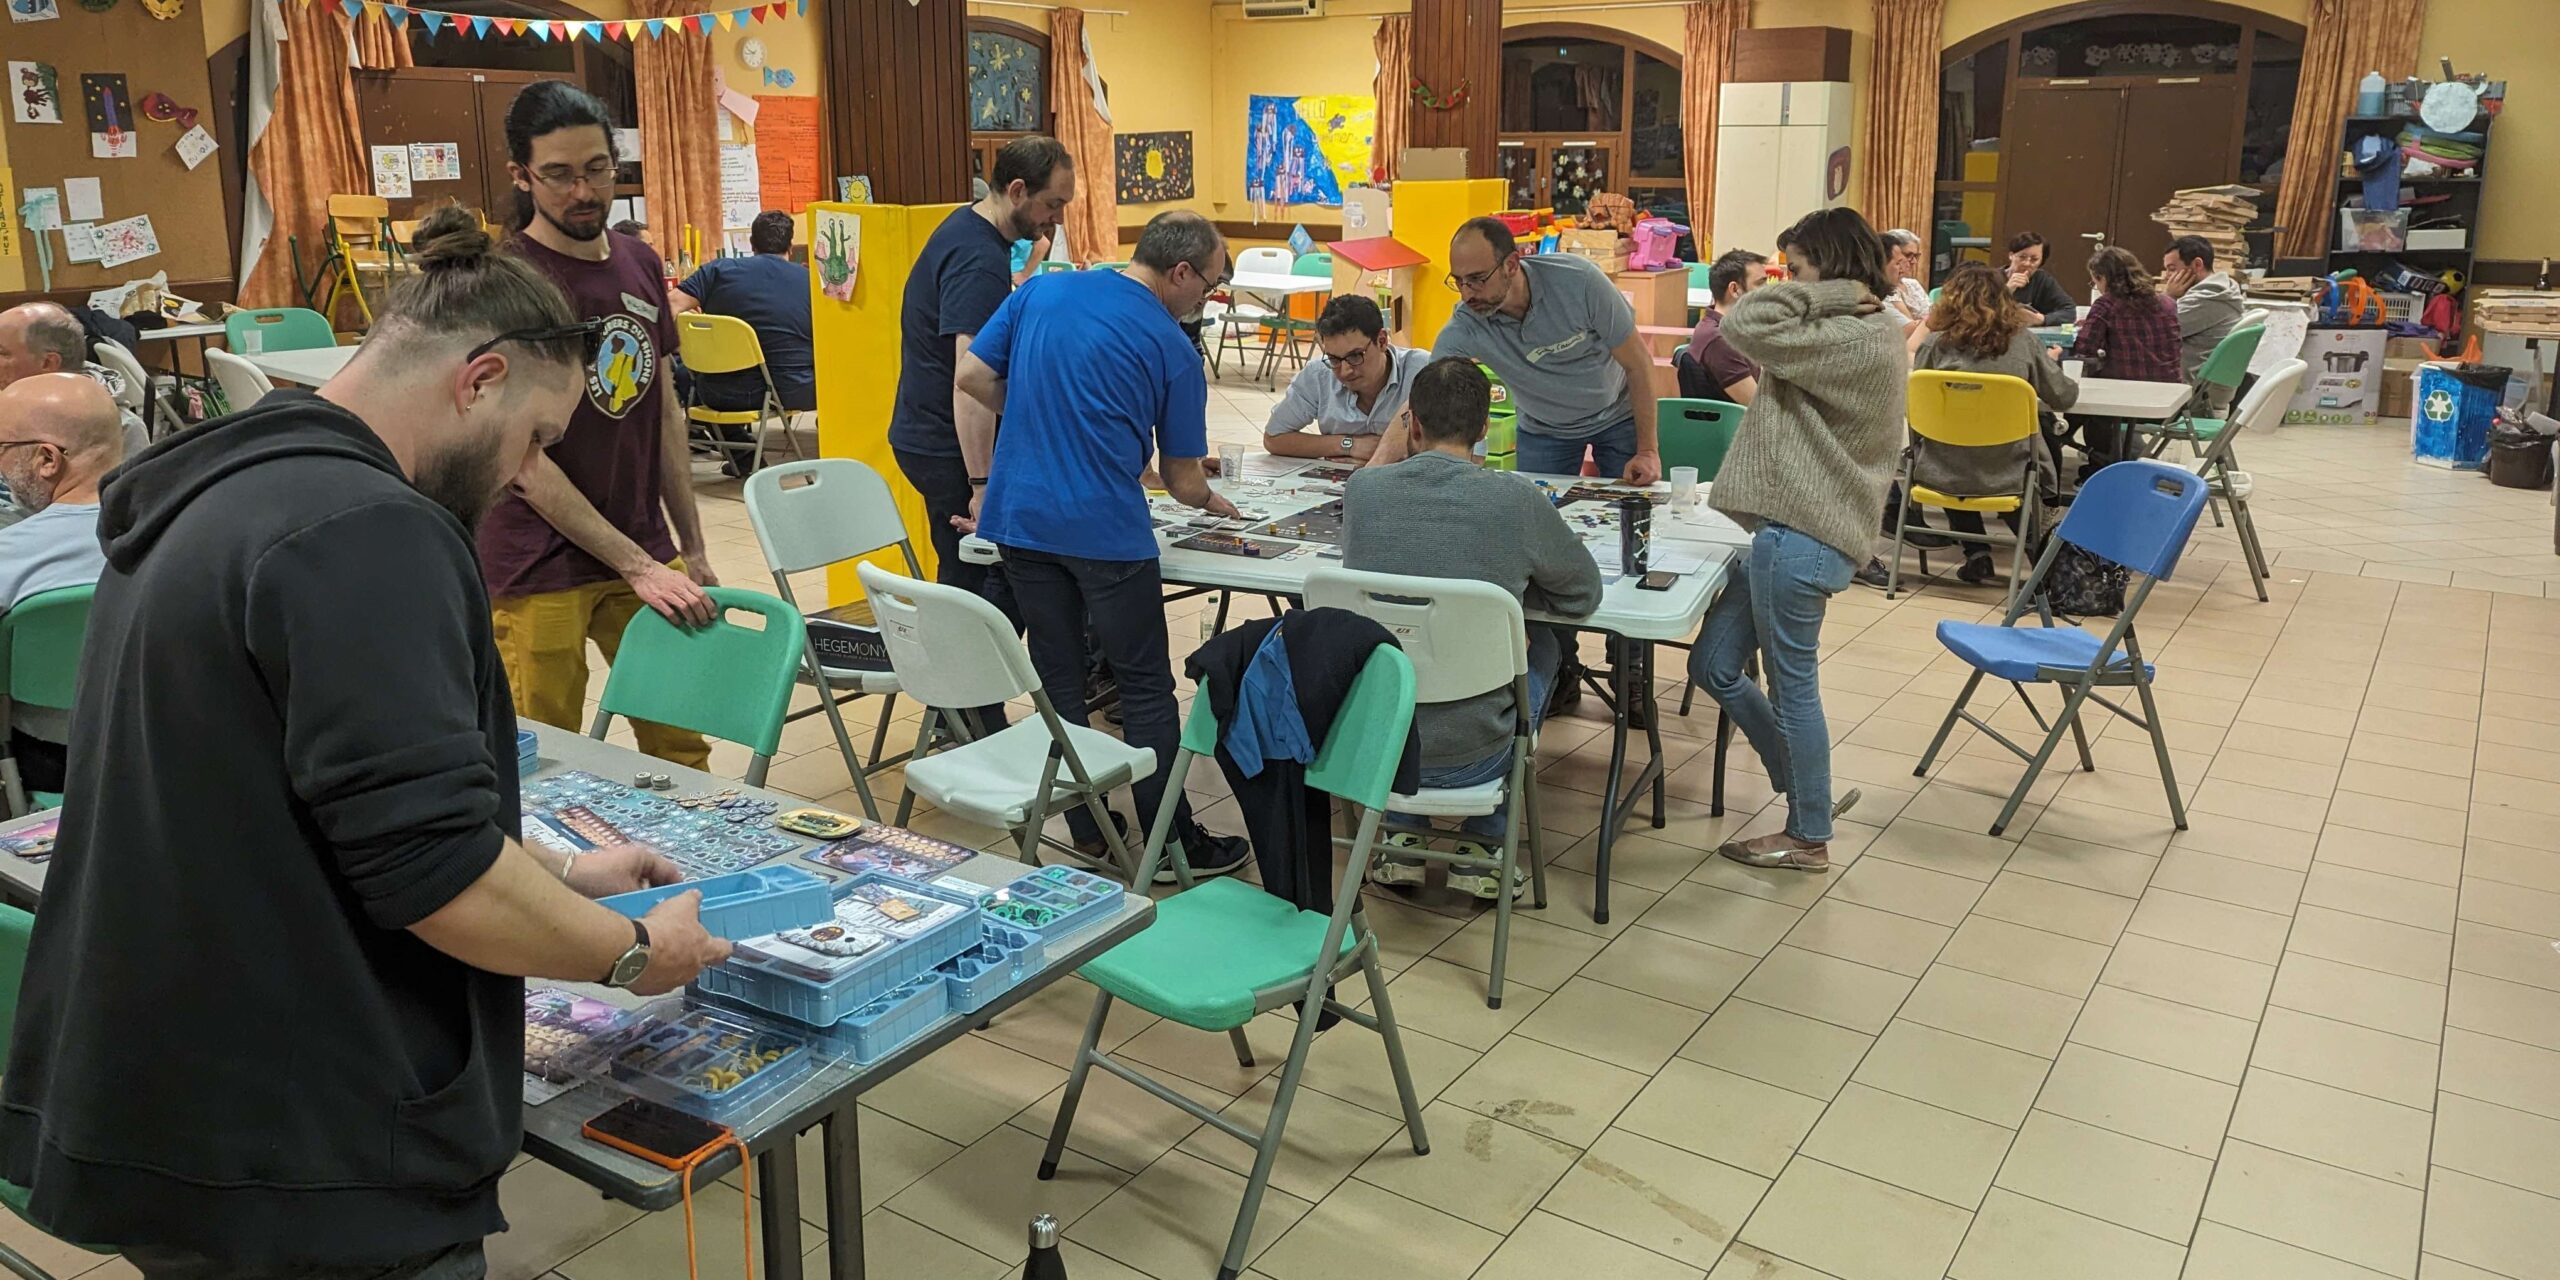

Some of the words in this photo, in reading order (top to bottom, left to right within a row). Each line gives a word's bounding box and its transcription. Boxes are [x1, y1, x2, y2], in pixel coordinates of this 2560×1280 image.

[589, 376, 603, 398] LES
[630, 324, 645, 340] DU
[640, 340, 652, 385] RHONE
[814, 638, 887, 658] HEGEMONY
